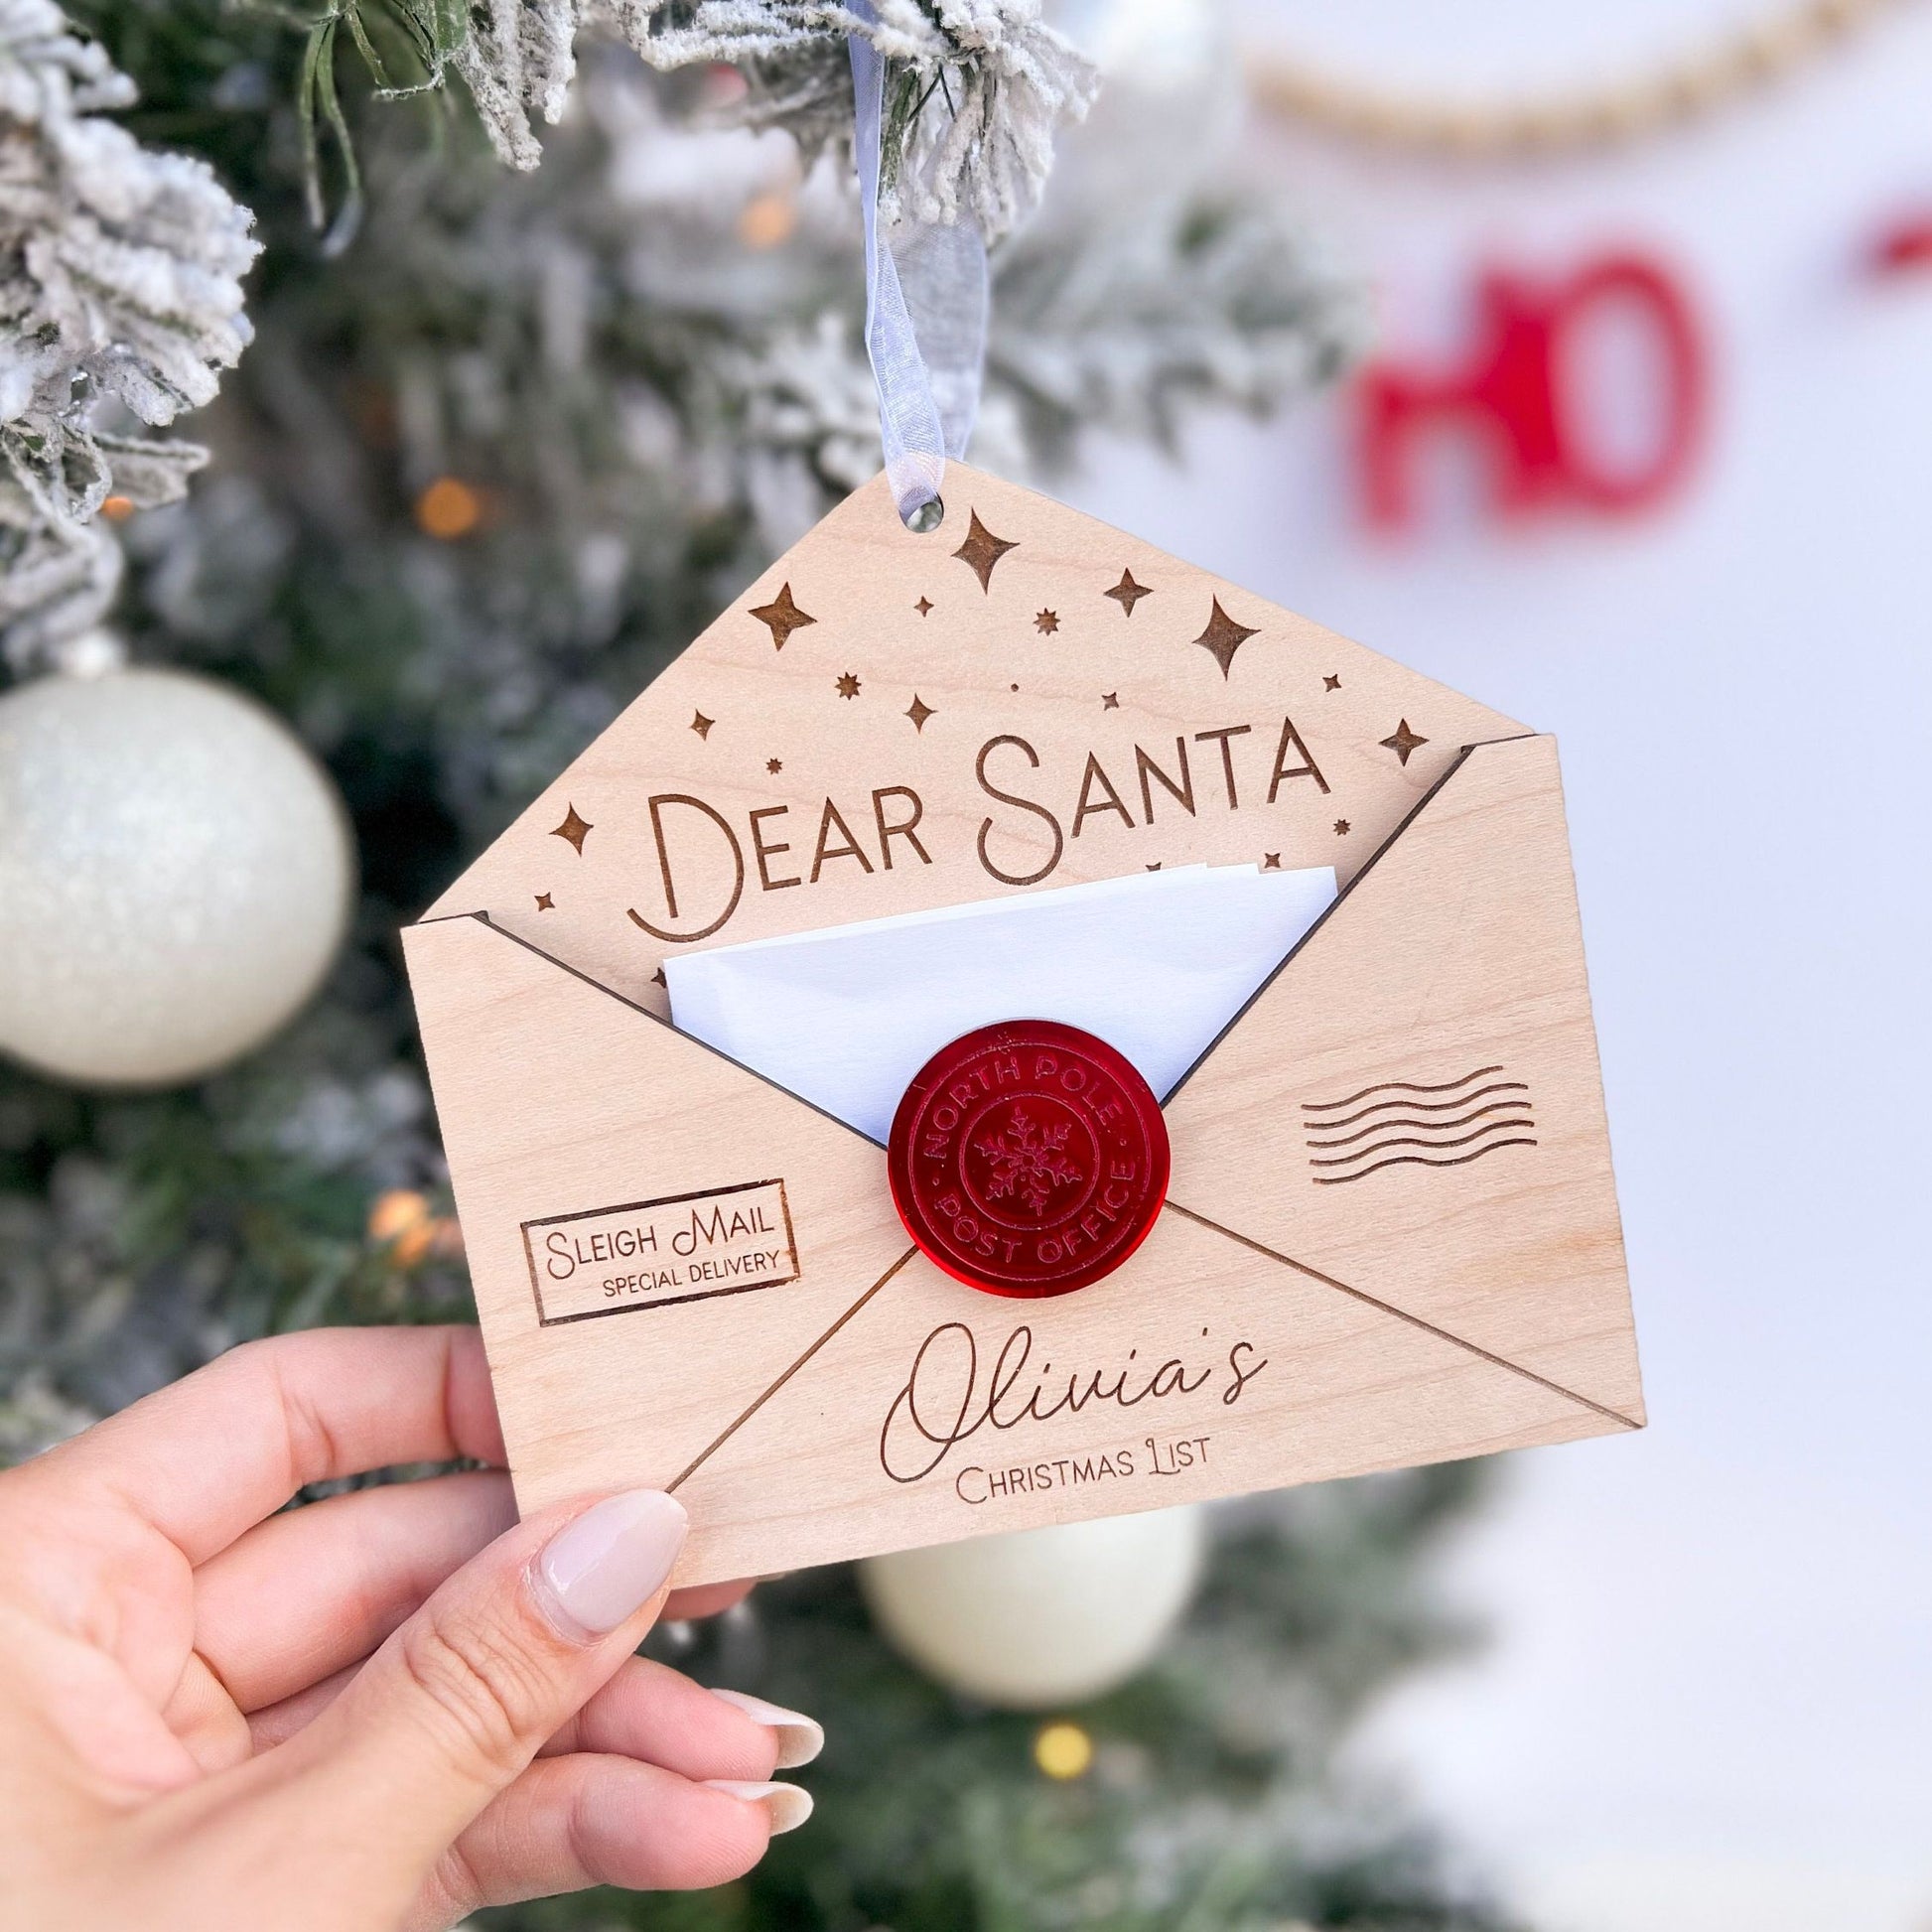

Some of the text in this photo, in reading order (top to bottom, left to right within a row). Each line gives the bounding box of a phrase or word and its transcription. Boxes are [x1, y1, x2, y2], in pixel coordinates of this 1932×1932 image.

[626, 715, 1332, 944] DEAR SANTA
[923, 1055, 1124, 1161] NORTH POLE
[545, 1204, 775, 1281] SLEIGH MAIL
[933, 1160, 1137, 1264] POST OFFICE
[603, 1249, 781, 1299] SPECIAL DELIVERY
[880, 1321, 1270, 1484] Olivia's
[956, 1437, 1211, 1505] CHRISTMAS LIST
